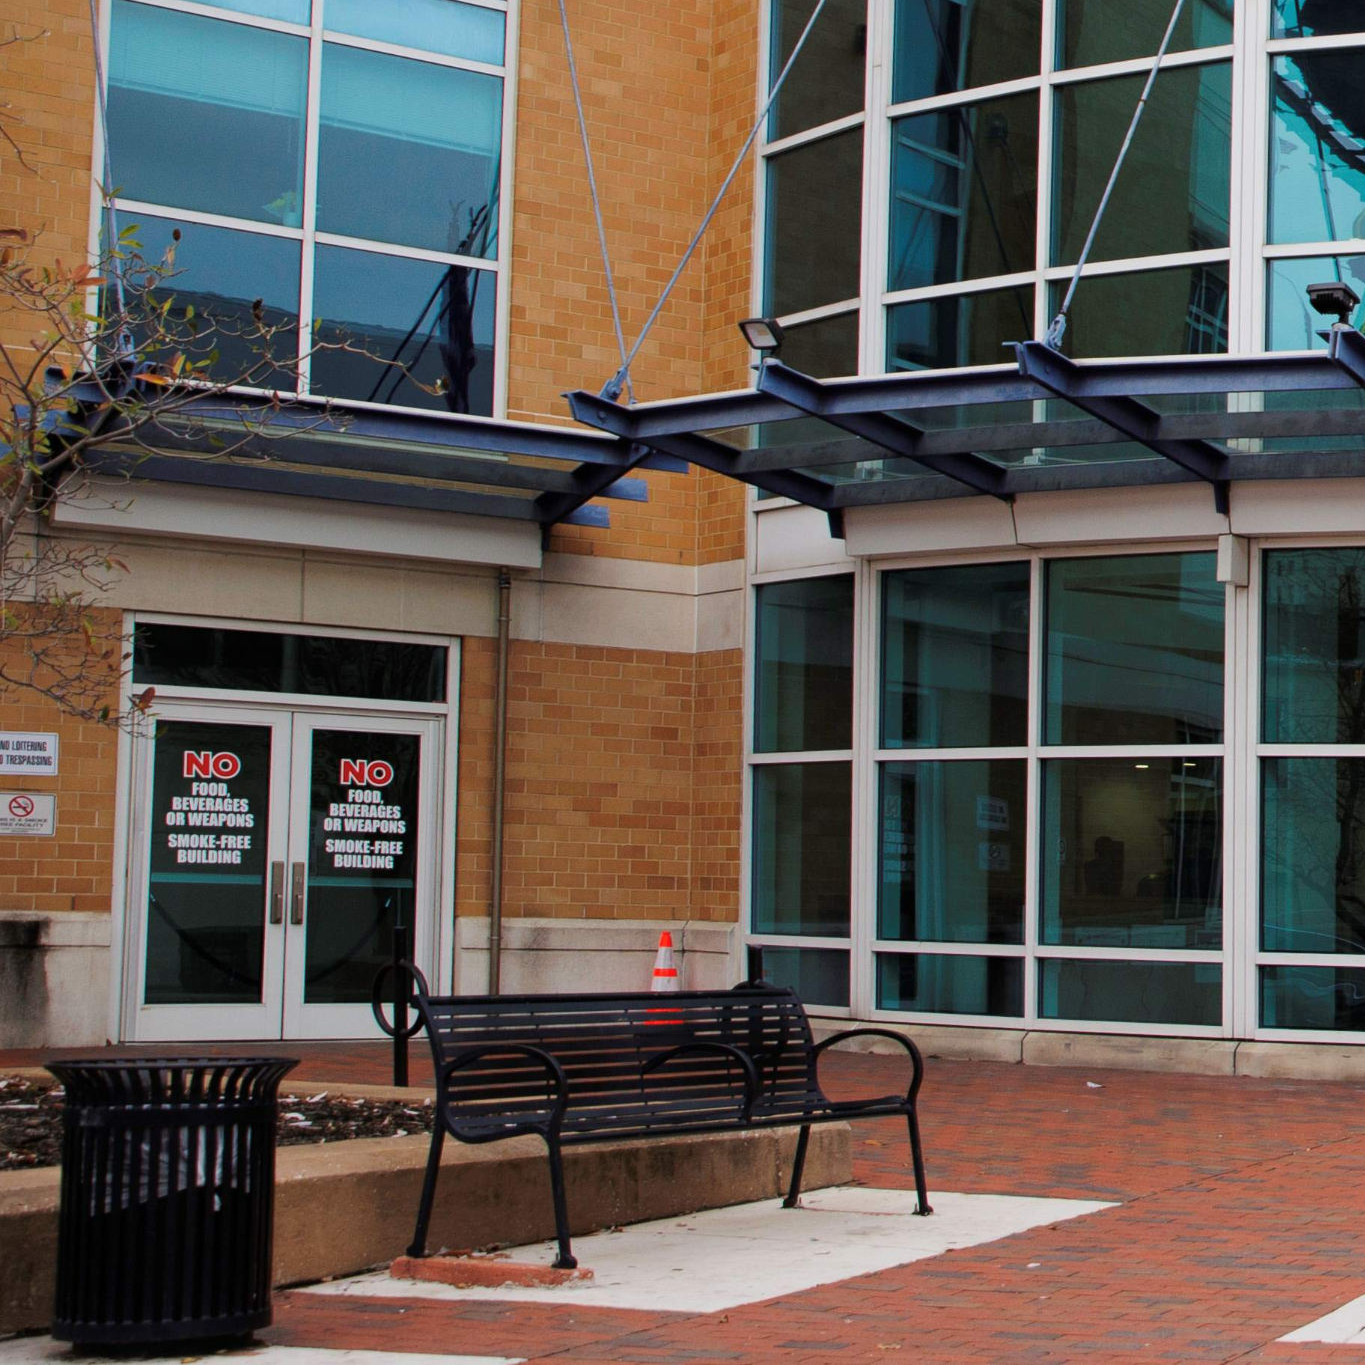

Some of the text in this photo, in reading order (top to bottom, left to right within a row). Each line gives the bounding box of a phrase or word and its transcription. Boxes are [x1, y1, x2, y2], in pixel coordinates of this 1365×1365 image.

[12, 740, 48, 752] LOITERING
[6, 754, 53, 766] TRESPASSING
[184, 750, 241, 779] NO
[340, 758, 394, 787] NO
[192, 782, 230, 797] FOOD,
[348, 789, 384, 804] FOOD,
[172, 796, 249, 812] BEVERAGES
[329, 803, 401, 819] BEVERAGES
[166, 811, 254, 828] OR WEAPONS
[324, 817, 406, 834] OR WEAPONS
[168, 833, 251, 849] SMOKE-FREE
[325, 839, 403, 855] SMOKE-FREE
[177, 849, 241, 864] BUILDING
[334, 854, 394, 869] BUILDING
